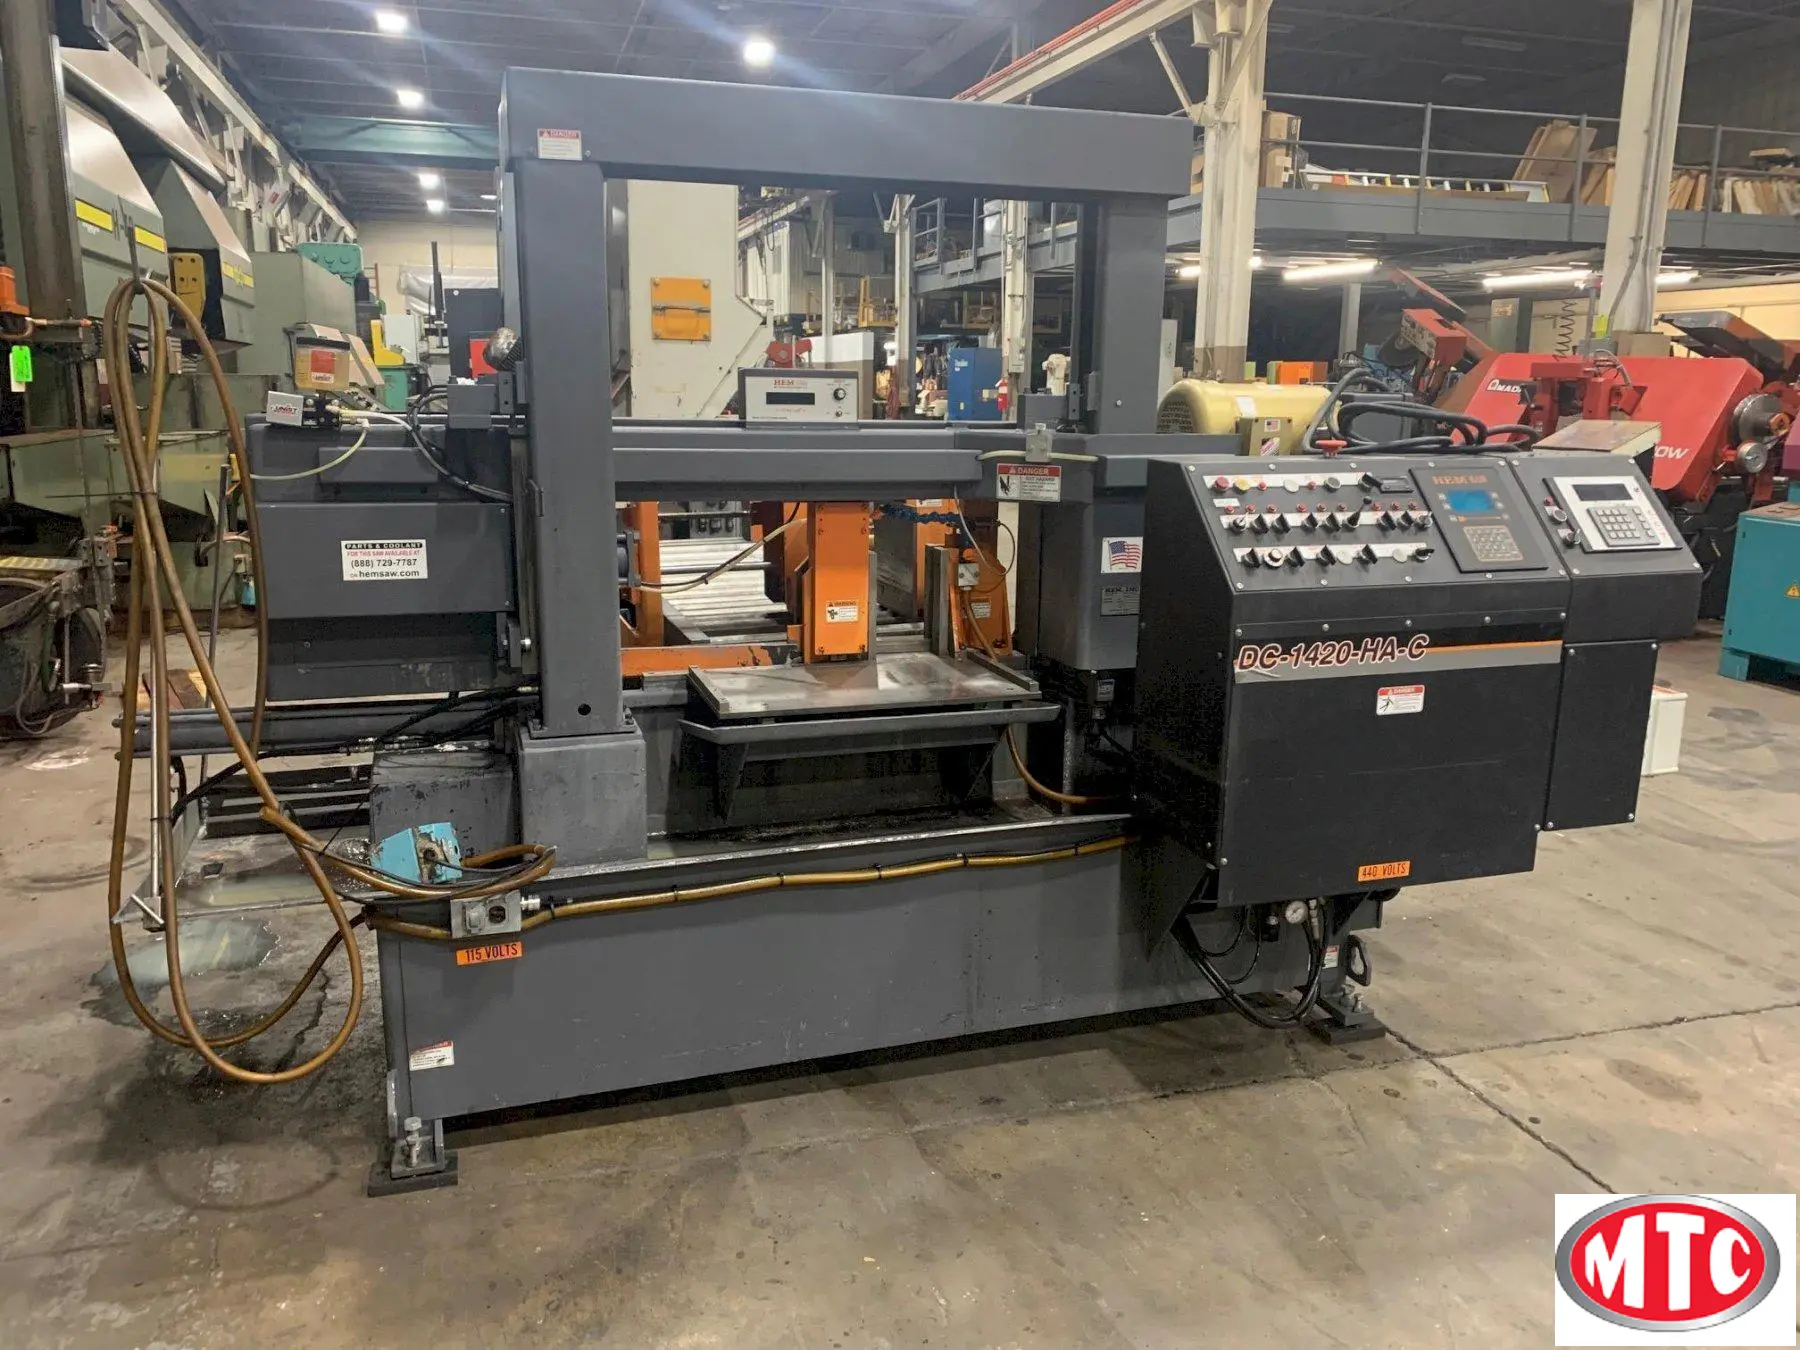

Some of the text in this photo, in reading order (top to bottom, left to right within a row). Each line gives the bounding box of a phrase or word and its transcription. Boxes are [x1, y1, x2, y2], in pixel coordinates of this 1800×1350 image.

[1017, 466, 1049, 475] DANGER
[351, 559, 374, 569] (888)
[359, 570, 420, 578] hemsaw.com
[1238, 633, 1430, 671] DC-1420-HA-C
[1362, 862, 1407, 877] 440 VOLTS
[466, 943, 518, 963] 115 VOLTS
